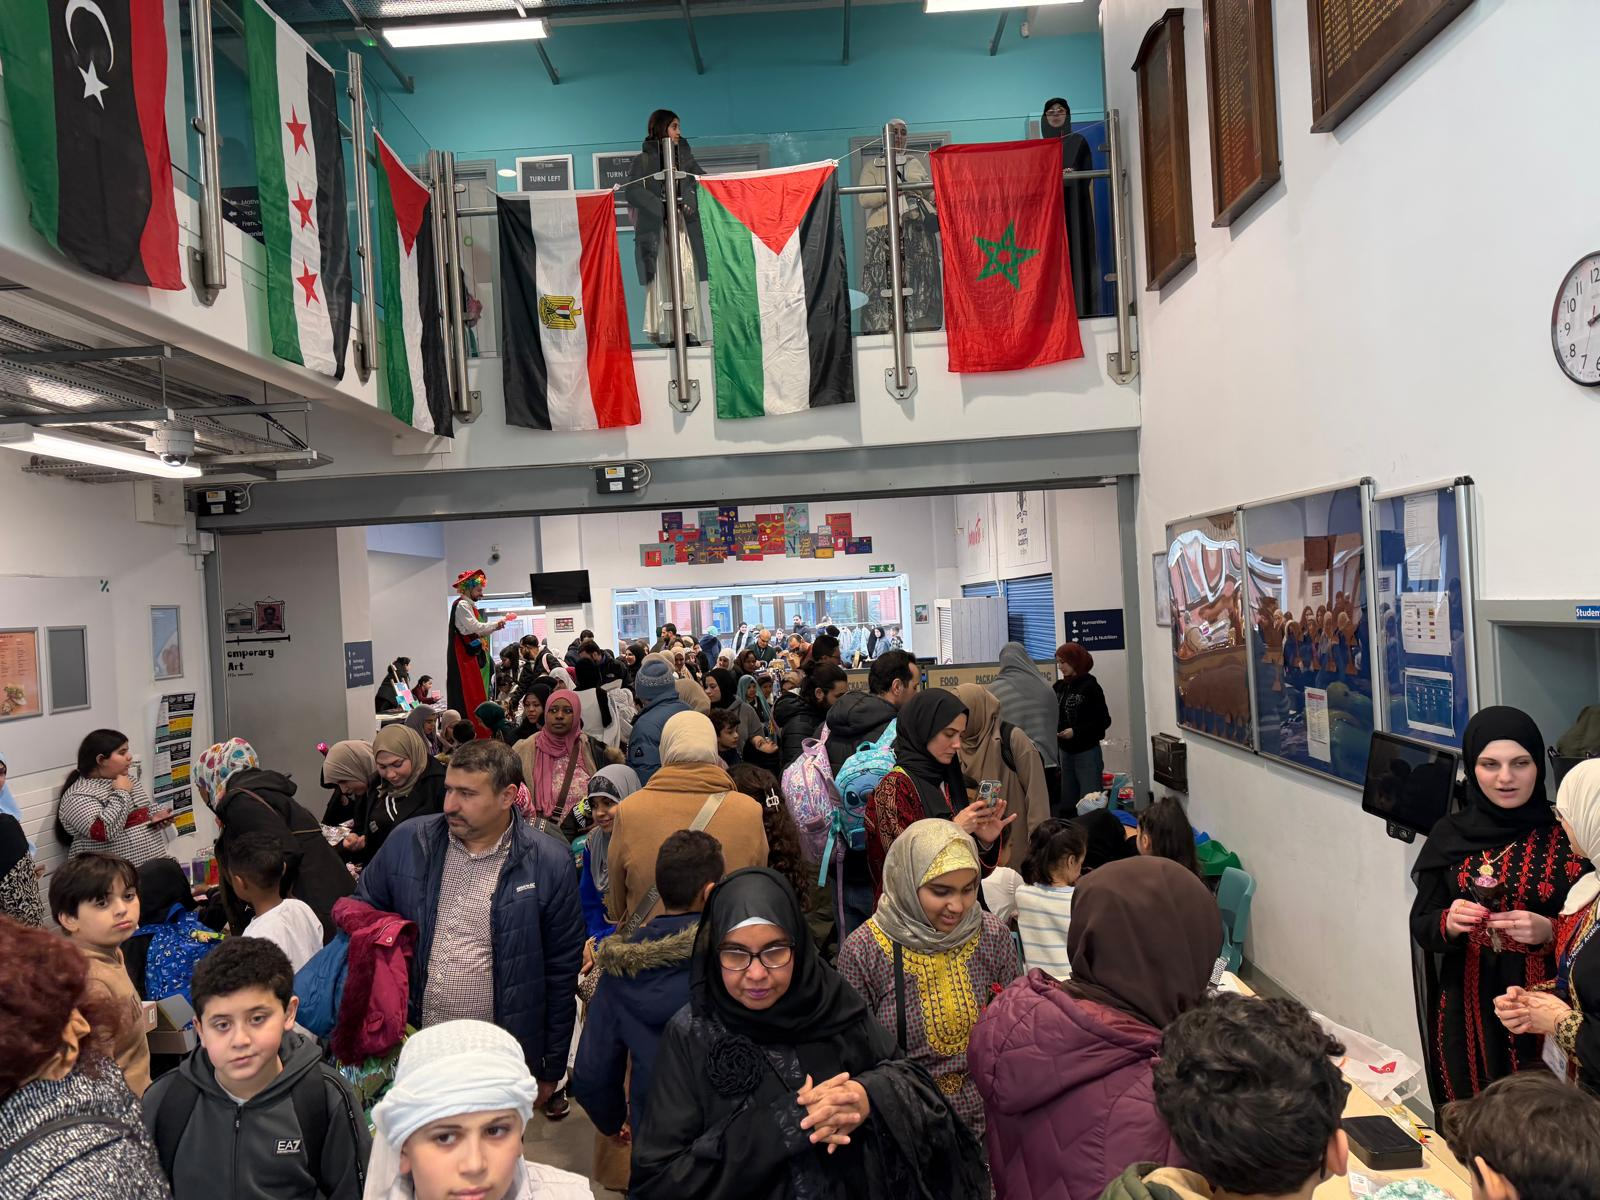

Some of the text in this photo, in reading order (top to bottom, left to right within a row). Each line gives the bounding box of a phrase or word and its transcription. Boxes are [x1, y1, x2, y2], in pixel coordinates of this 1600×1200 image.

[1590, 268, 1600, 284] 12
[1576, 280, 1583, 296] 11
[1566, 298, 1576, 313] 10
[1565, 322, 1571, 336] 9
[1569, 343, 1576, 358] 8
[1581, 354, 1587, 369] 7
[228, 662, 244, 671] Art
[940, 676, 959, 686] FOOD
[277, 1140, 301, 1151] EA7
